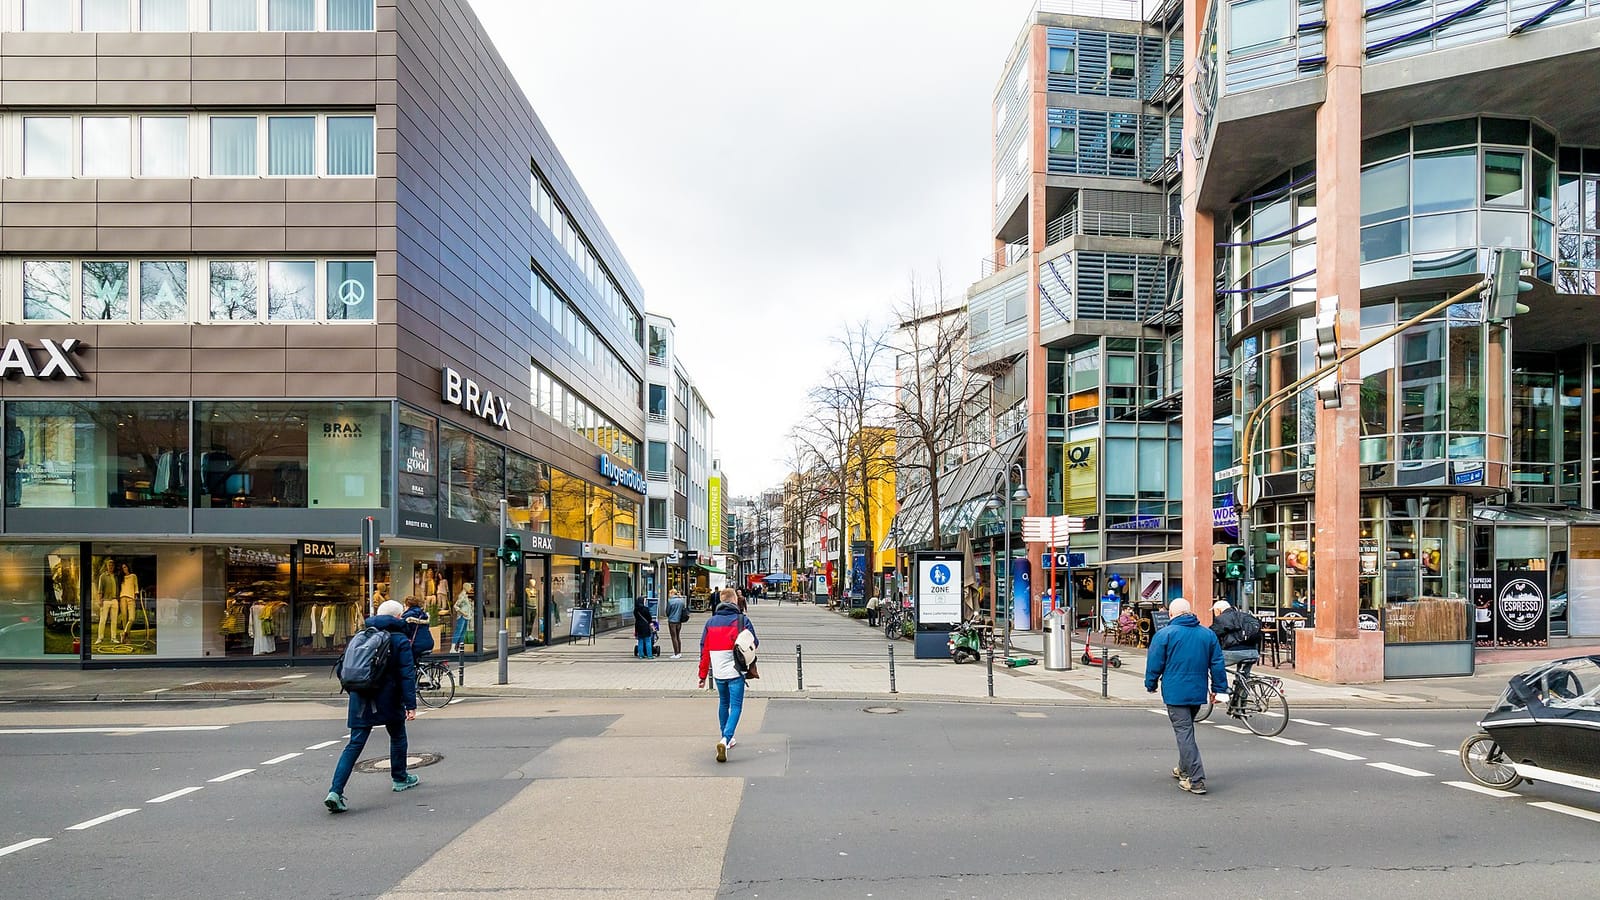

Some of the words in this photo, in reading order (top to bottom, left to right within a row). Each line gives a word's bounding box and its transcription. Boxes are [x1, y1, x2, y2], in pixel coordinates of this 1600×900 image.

[442, 366, 512, 431] BRAX
[323, 422, 362, 433] BRAX
[412, 446, 425, 460] feel
[406, 457, 429, 473] good
[711, 486, 719, 541] TIMEPARTNER
[1213, 507, 1236, 520] WDR
[405, 519, 420, 528] BREITE
[303, 543, 334, 556] BRAX
[532, 536, 553, 550] BRAX
[930, 586, 950, 594] ZONE
[1503, 600, 1539, 612] ESPRESSO
